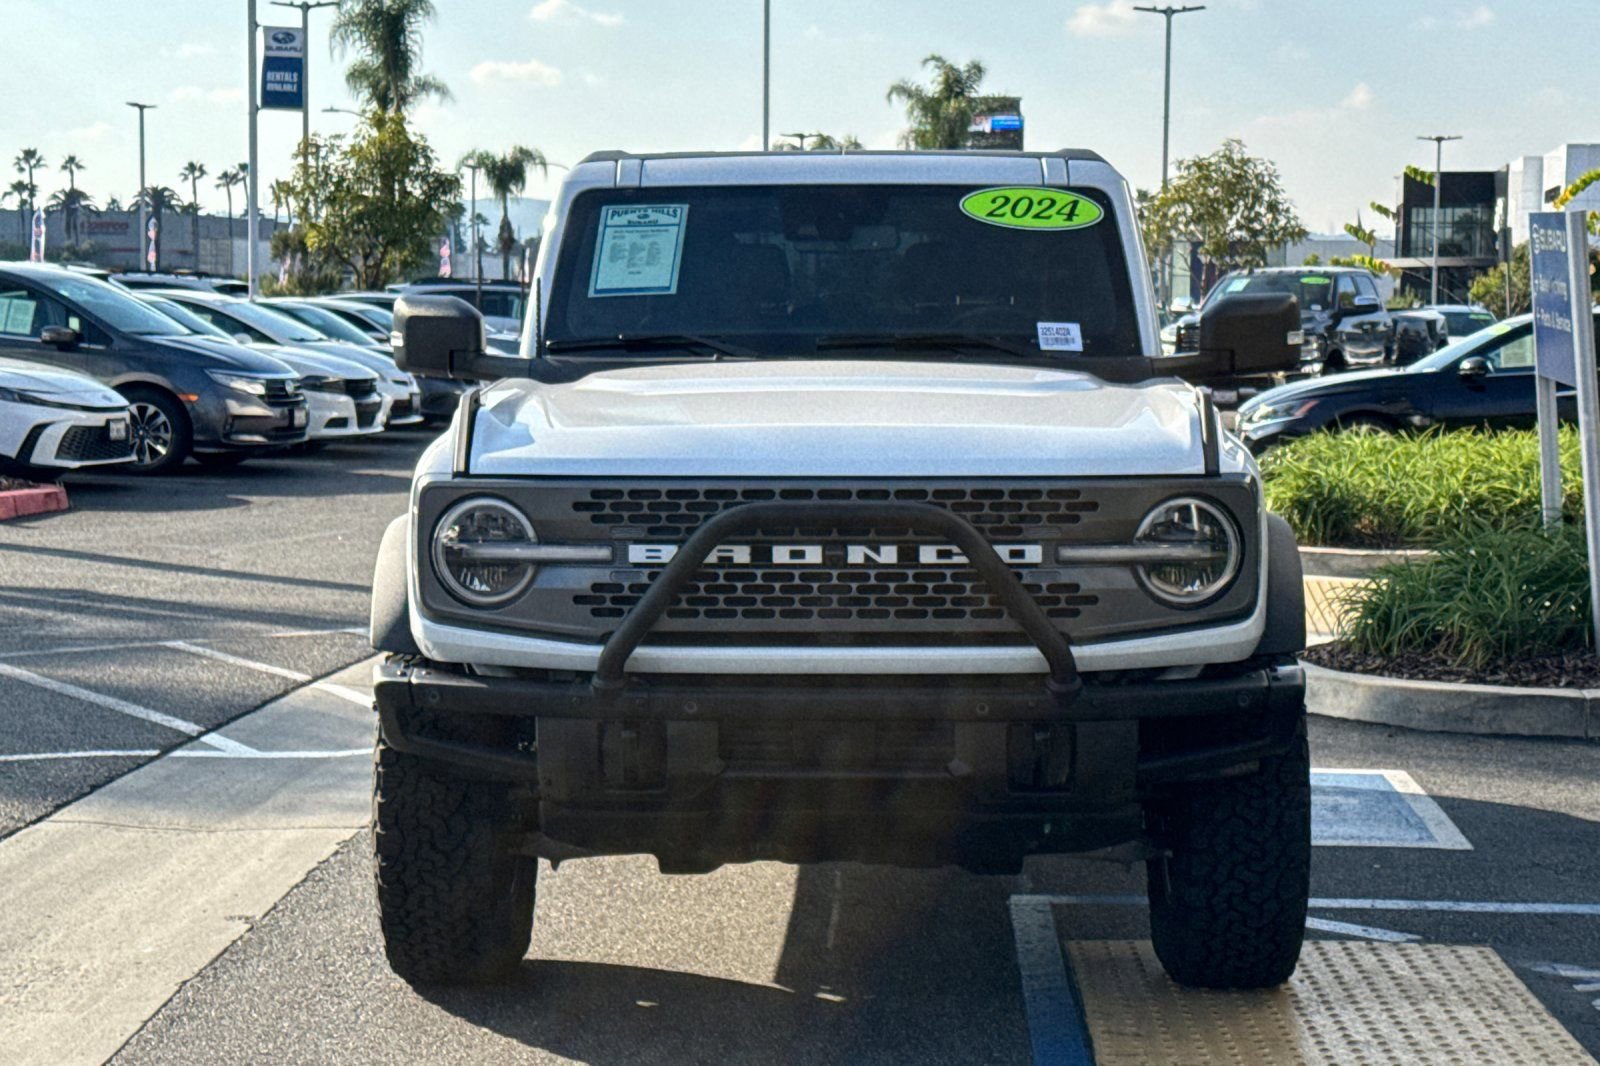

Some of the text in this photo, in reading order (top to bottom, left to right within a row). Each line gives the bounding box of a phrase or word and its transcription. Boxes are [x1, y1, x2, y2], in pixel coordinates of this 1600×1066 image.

[266, 71, 299, 82] RENTALS
[651, 207, 679, 218] HILLS
[985, 195, 1080, 222] 2024
[1540, 228, 1567, 253] SUBARU
[628, 544, 1043, 564] BRONCO
